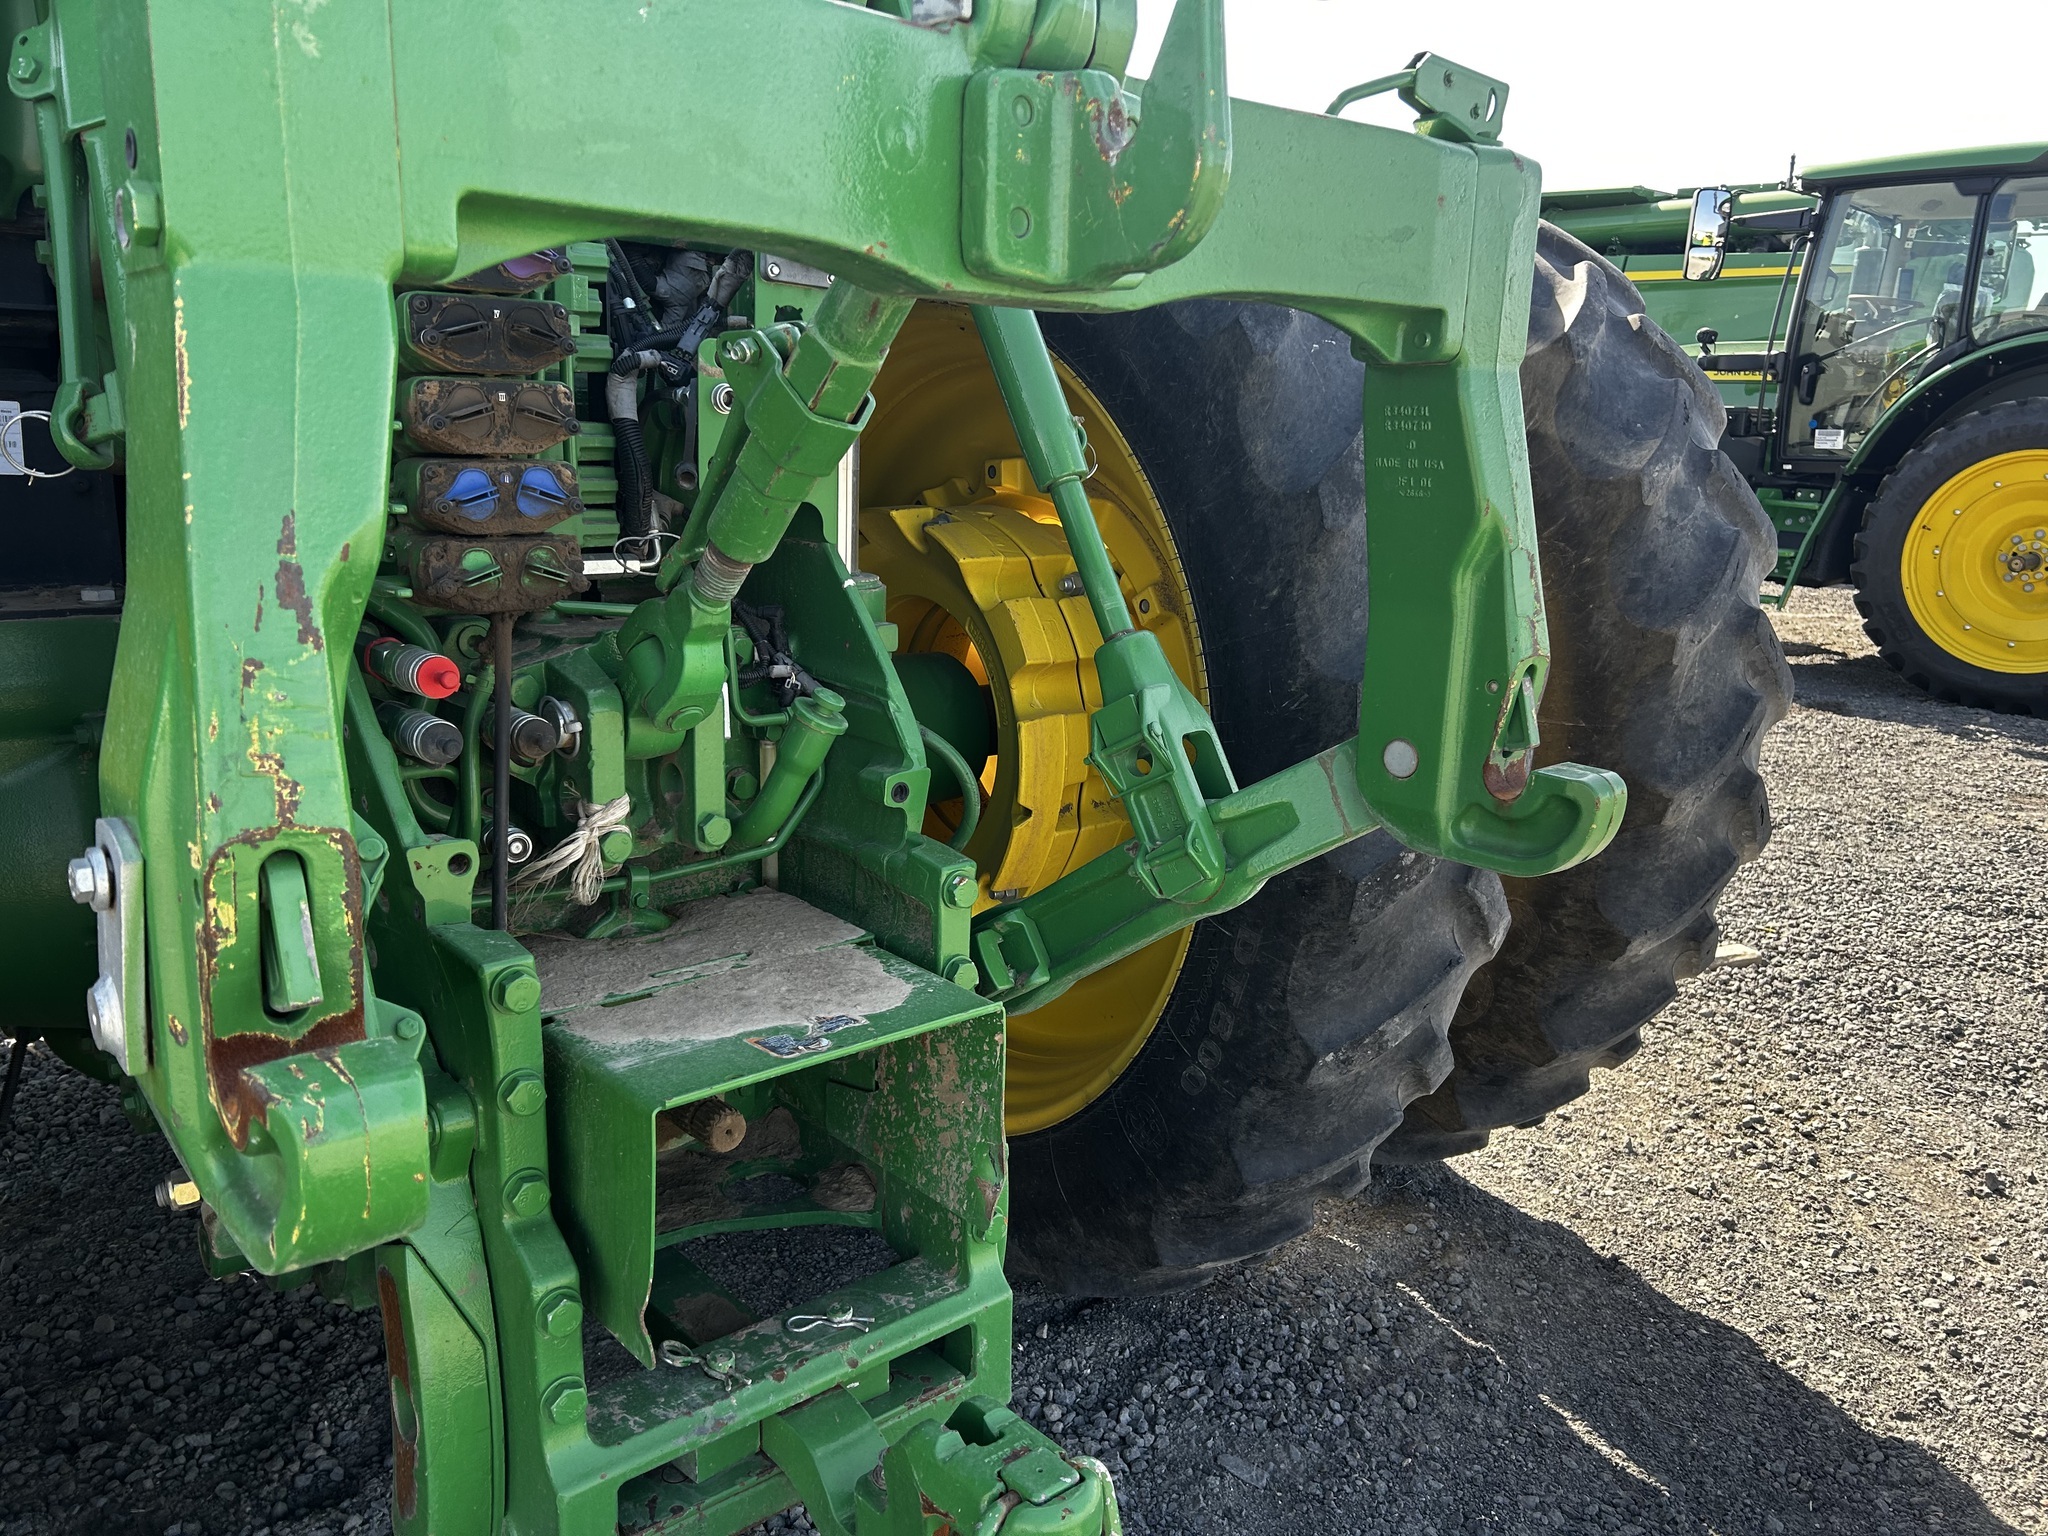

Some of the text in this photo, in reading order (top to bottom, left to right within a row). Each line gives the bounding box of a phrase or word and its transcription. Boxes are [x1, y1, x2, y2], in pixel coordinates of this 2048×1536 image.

[1384, 406, 1430, 417] R340731
[1375, 457, 1445, 470] MADE IN USA
